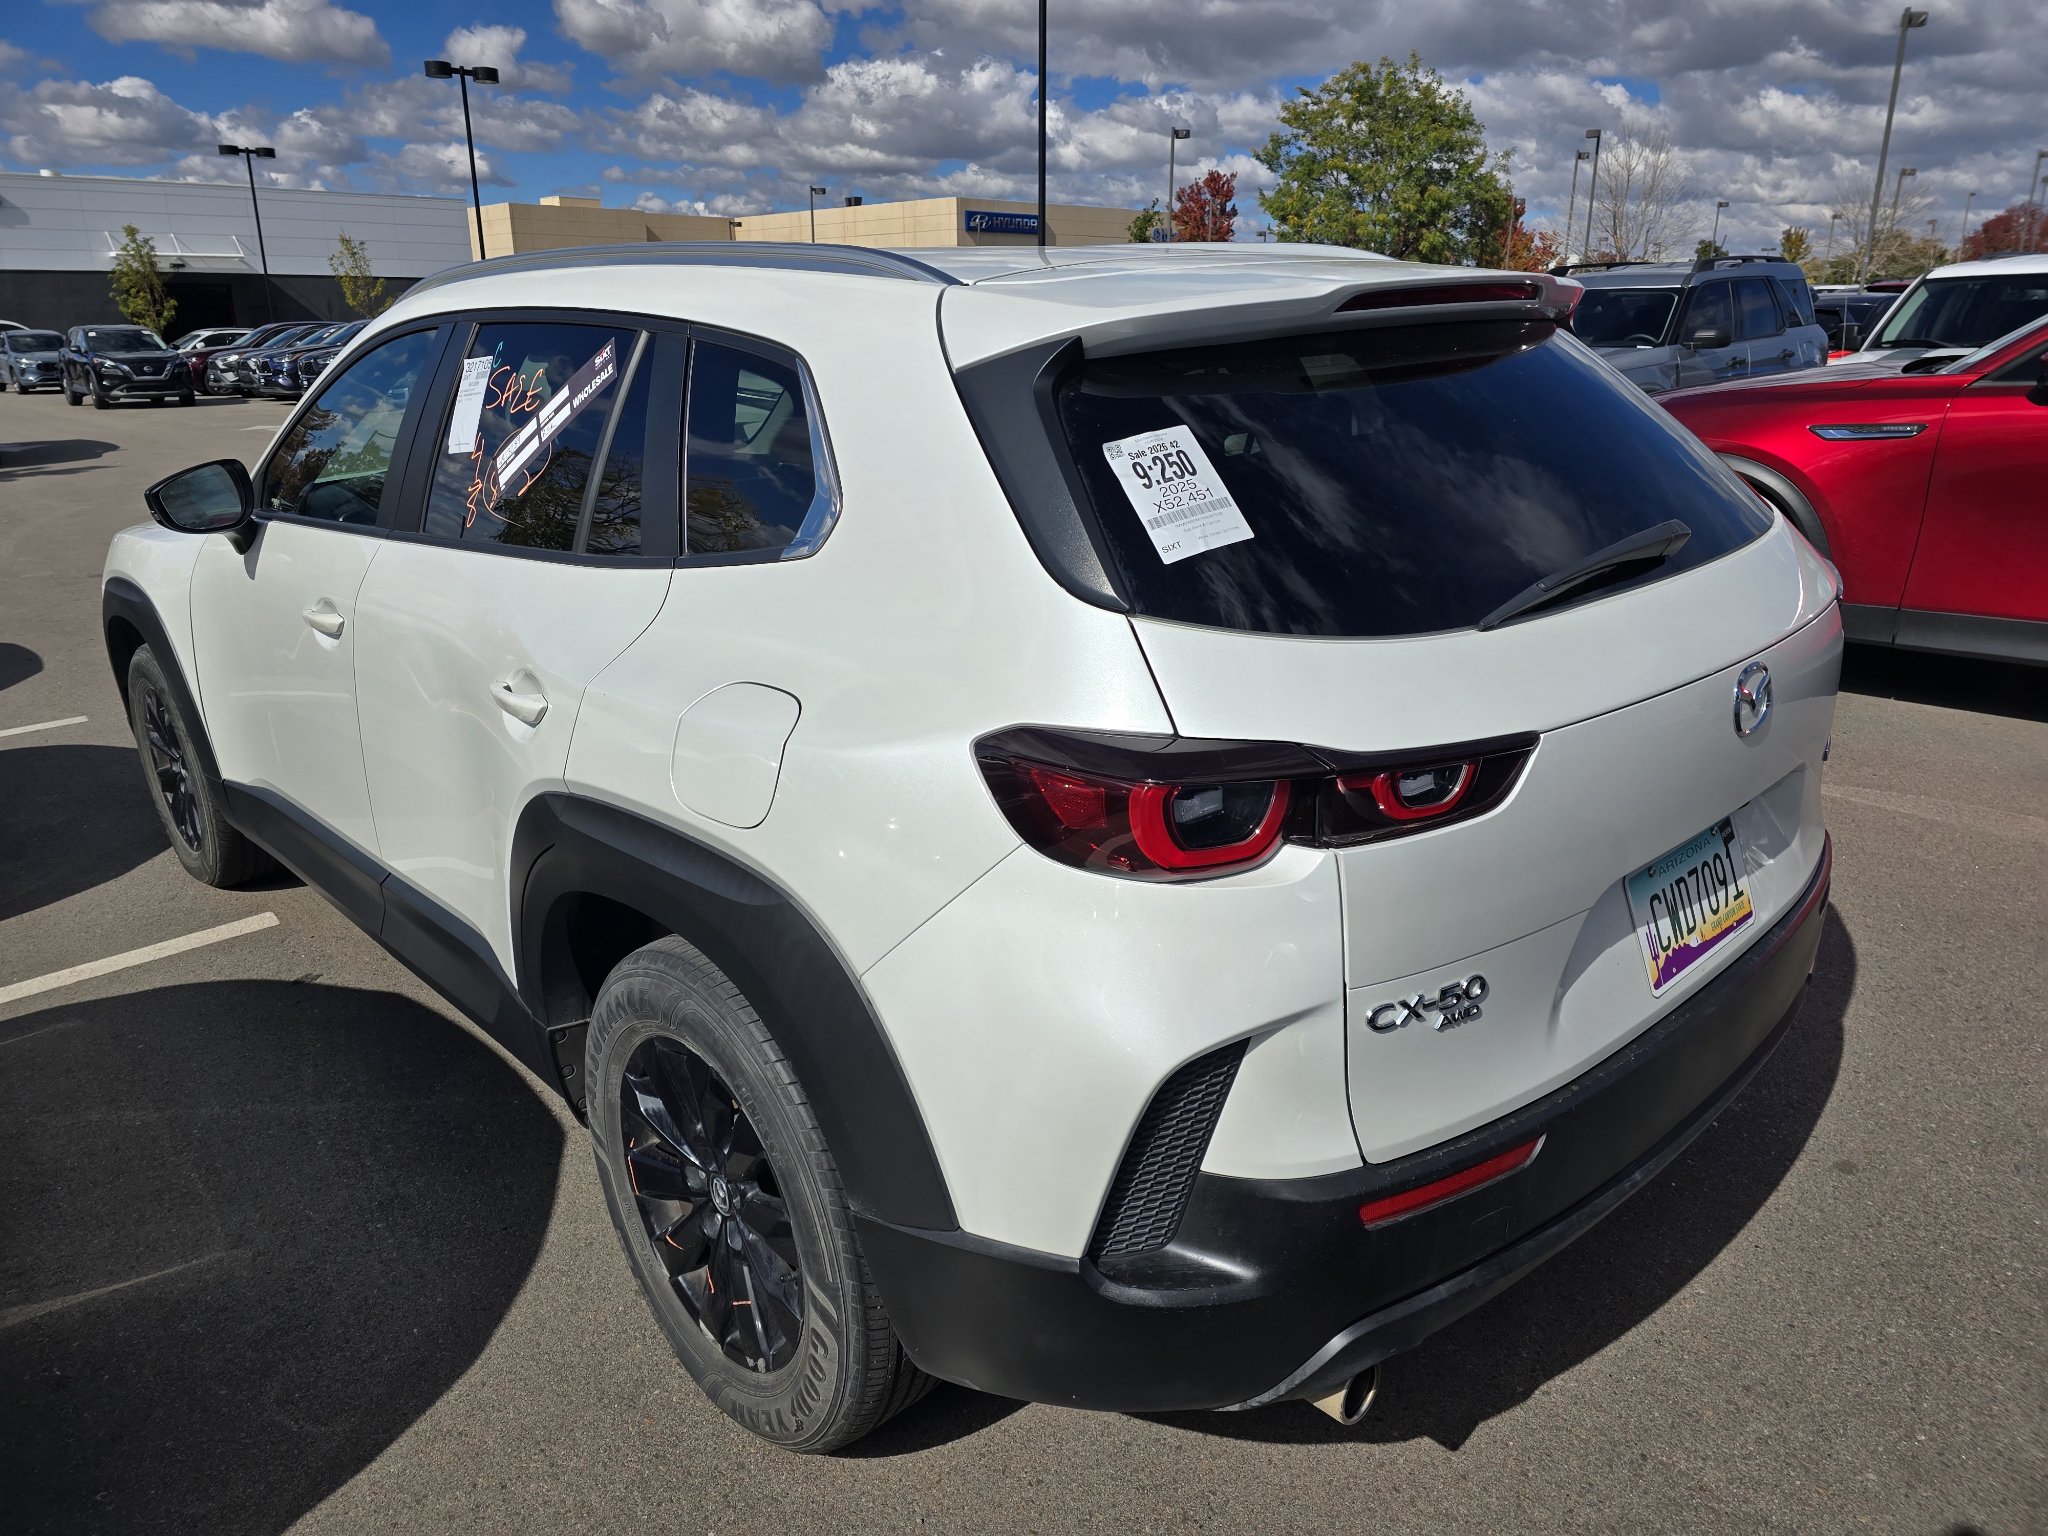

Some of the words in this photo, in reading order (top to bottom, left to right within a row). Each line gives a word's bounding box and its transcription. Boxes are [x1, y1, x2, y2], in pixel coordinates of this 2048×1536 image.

[993, 216, 1038, 230] HYUNDA
[486, 366, 544, 413] SALE
[573, 363, 613, 408] WHOLESALE
[1128, 450, 1147, 461] Sale
[1148, 443, 1168, 455] 2026
[1170, 440, 1180, 449] 42
[1153, 487, 1214, 513] X52,451
[1160, 479, 1197, 497] 2025
[1162, 541, 1182, 553] SIXT
[1658, 837, 1711, 877] ARIZONA
[1650, 846, 1744, 953] CWD7091
[1366, 974, 1488, 1031] CX-50
[1433, 1004, 1481, 1030] AWD
